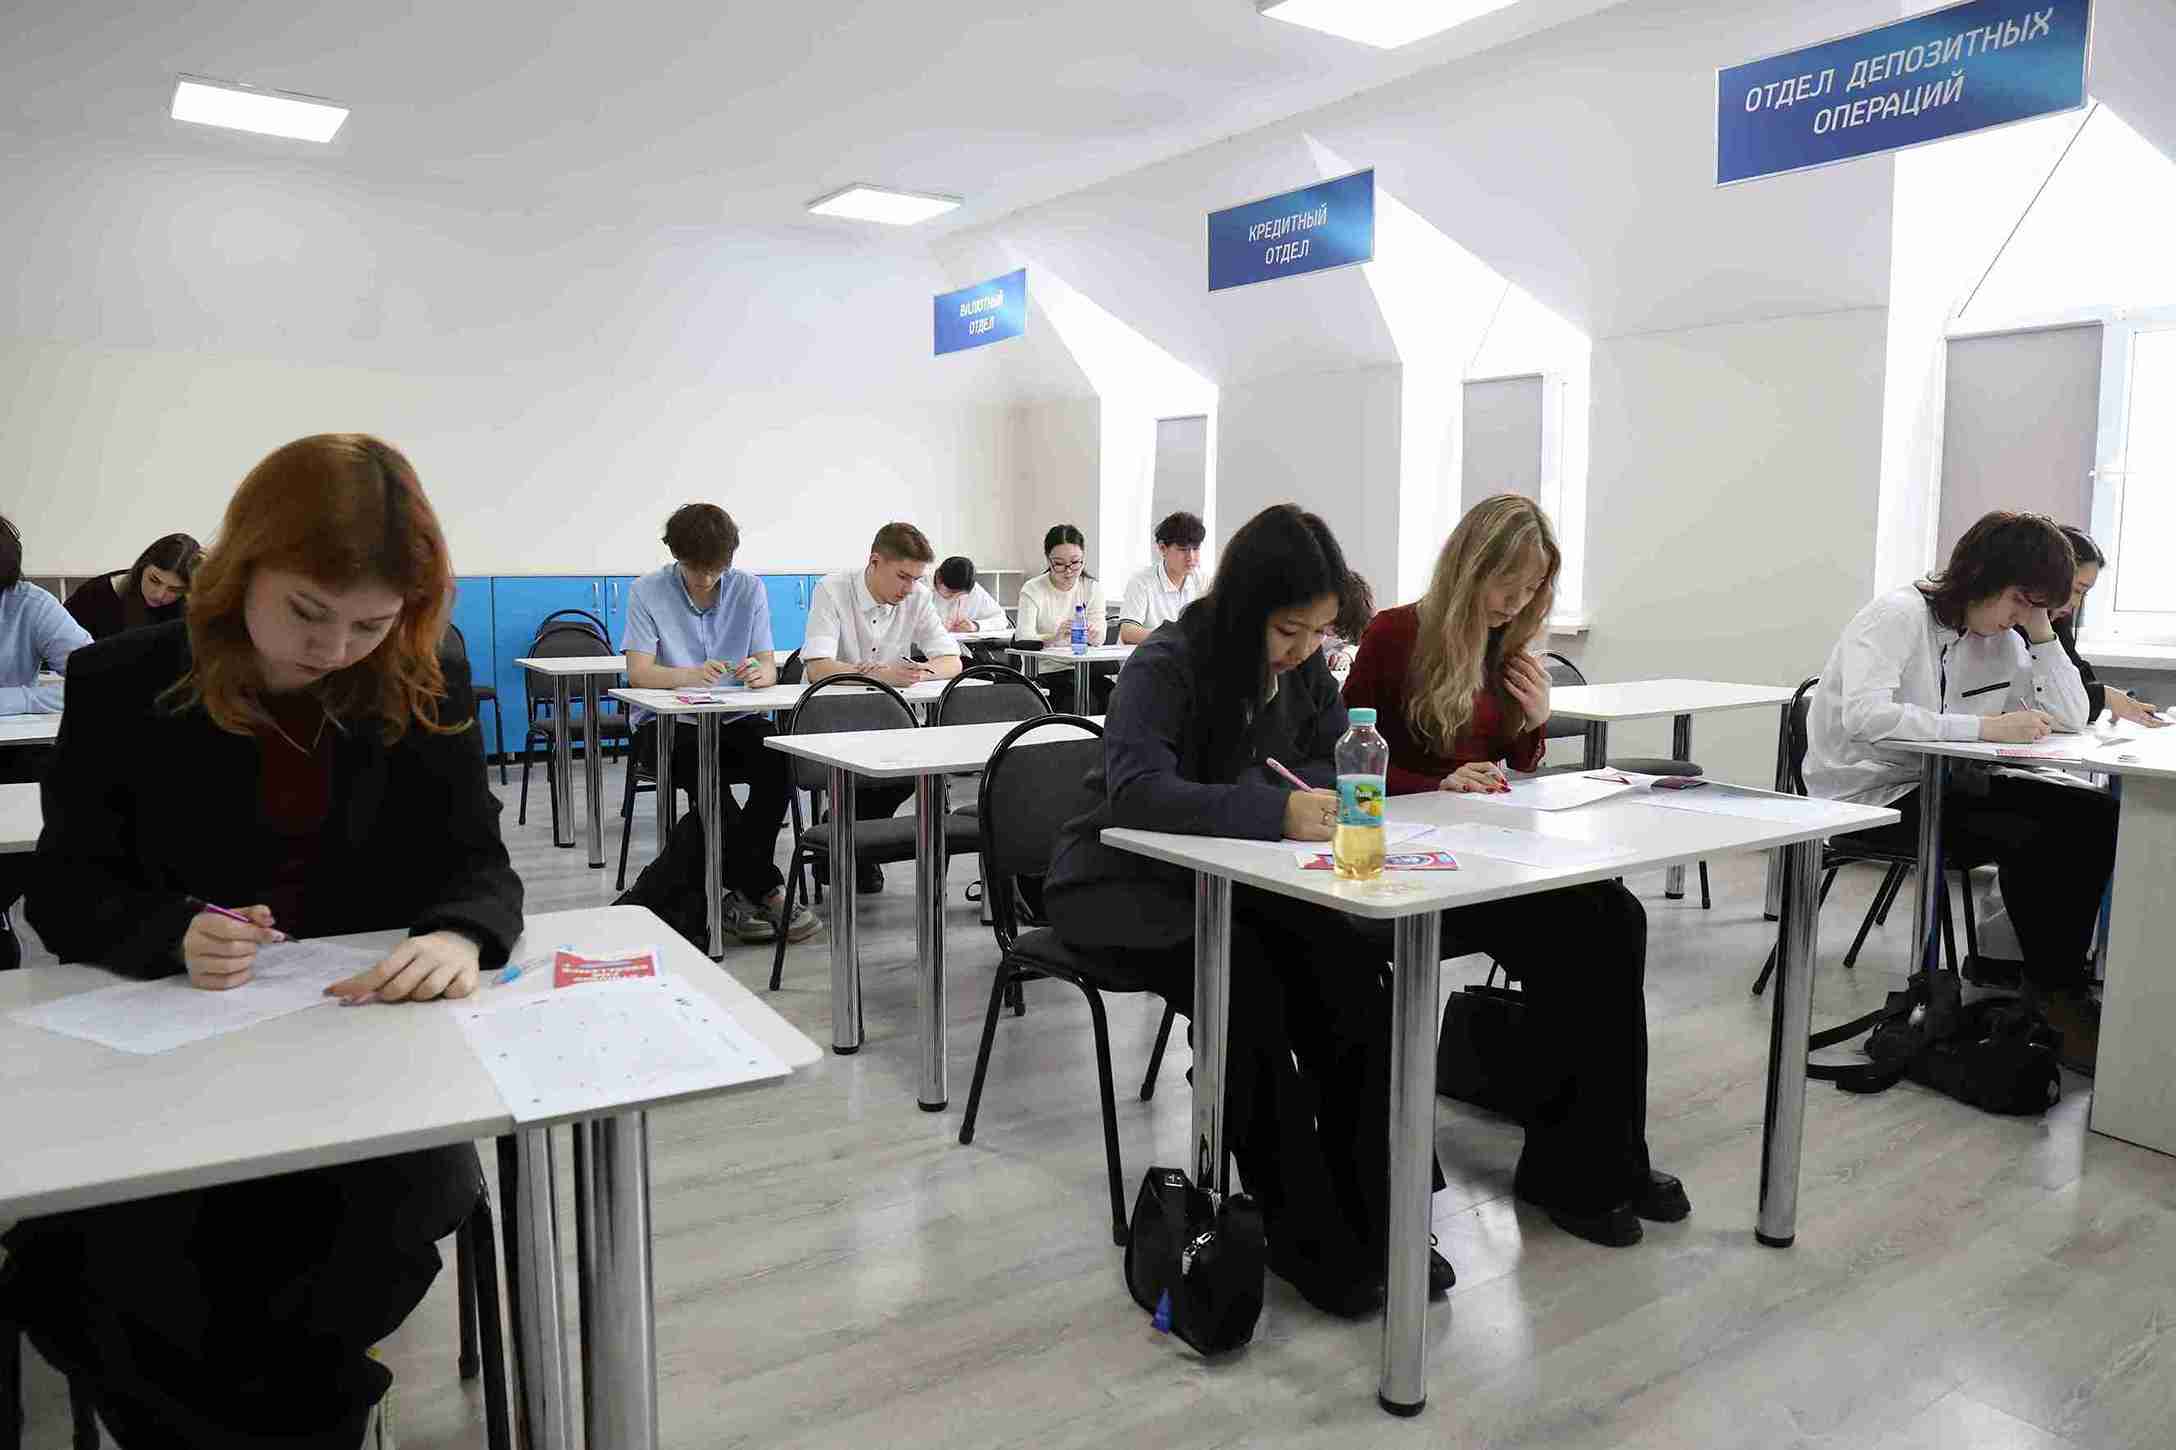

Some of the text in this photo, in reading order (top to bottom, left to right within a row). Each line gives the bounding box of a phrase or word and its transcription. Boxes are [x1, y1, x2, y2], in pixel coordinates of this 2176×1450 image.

[1745, 8, 2054, 112] ОТДЕЛ ДЕПОЗИТНЫХ
[1813, 69, 1965, 135] ОПЕРАЦИЙ
[1249, 202, 1328, 242] КРЕДИТНЫЙ
[1265, 240, 1310, 264] ОТДЕЛ
